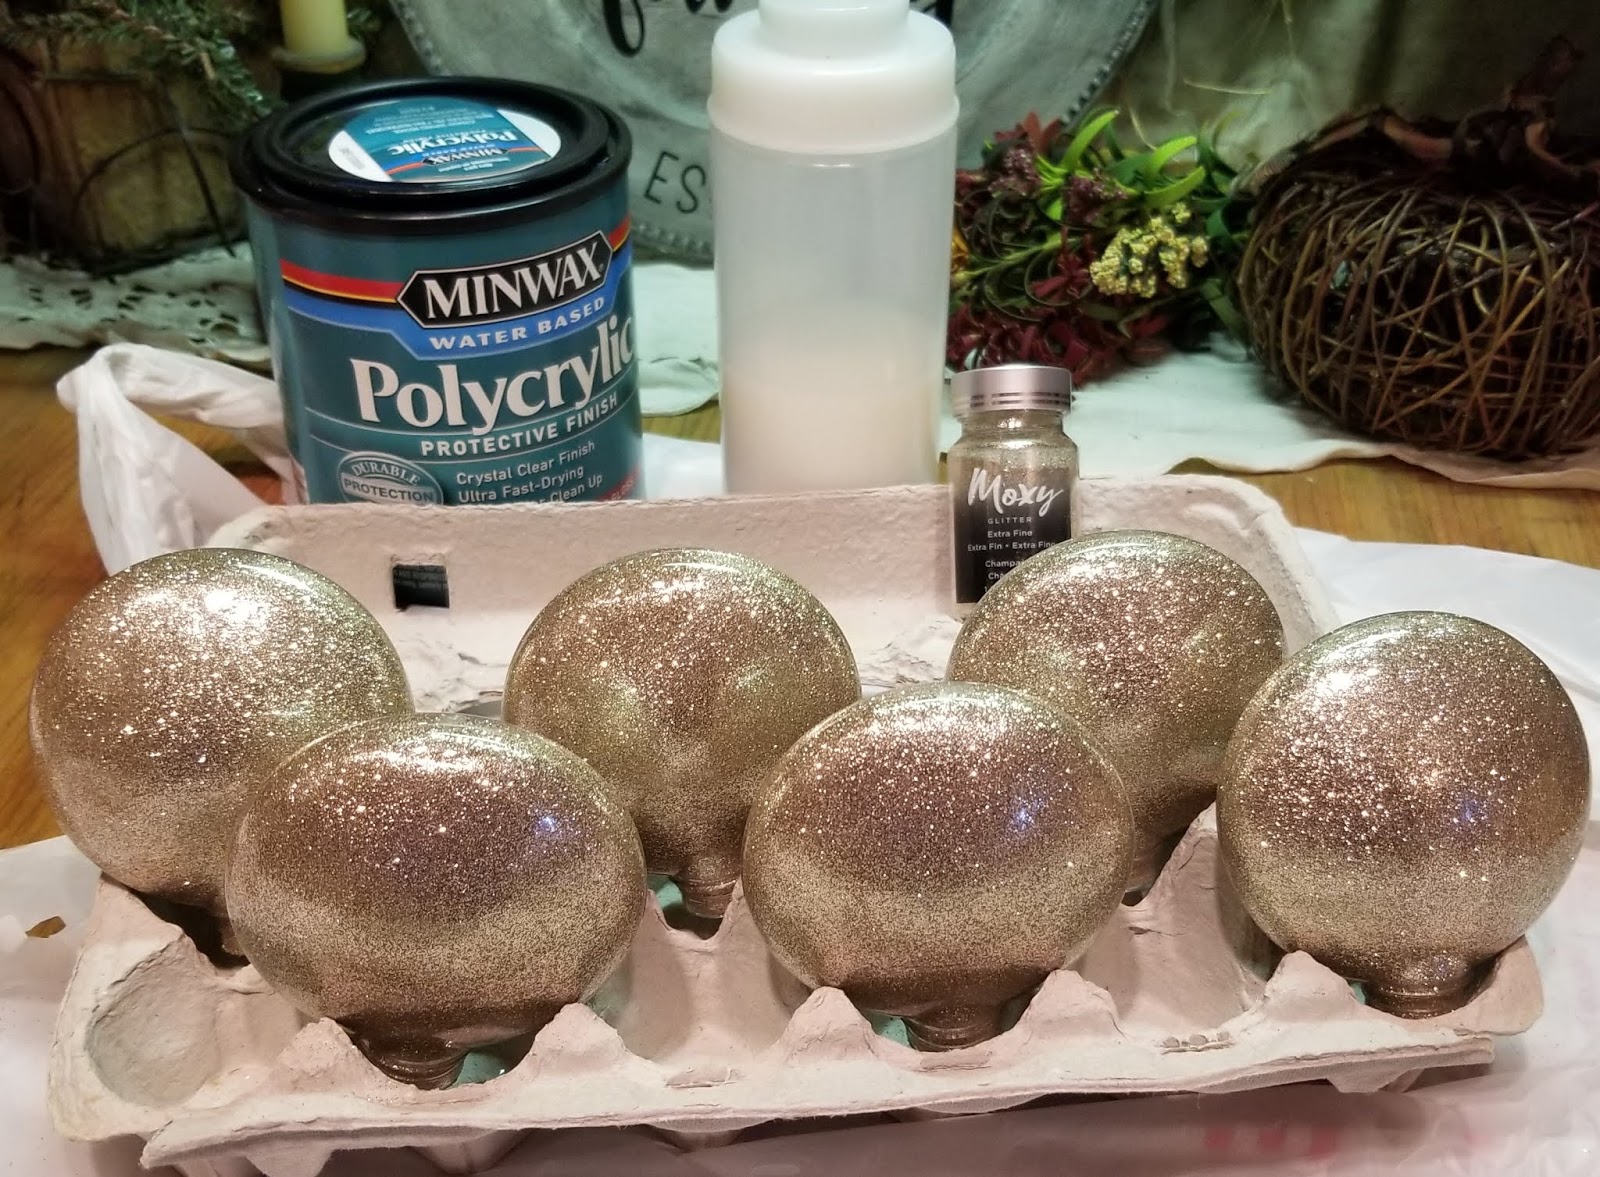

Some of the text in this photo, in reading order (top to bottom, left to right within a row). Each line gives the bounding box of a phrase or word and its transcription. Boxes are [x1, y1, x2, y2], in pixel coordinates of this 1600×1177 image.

[388, 129, 519, 155] Polycrylic
[433, 146, 503, 165] MINWAX
[423, 241, 601, 319] MINWAX
[429, 297, 605, 350] WATER BASED
[350, 314, 633, 436] Polycrylic
[421, 391, 618, 457] PROTECTIVE FINISH
[351, 461, 421, 486] DURABLE
[456, 440, 595, 487] Crystal Clear Finish
[344, 478, 434, 502] PROTECTION
[458, 465, 584, 504] Ultra Fast-Drying
[550, 474, 603, 503] Clean Up
[967, 467, 1064, 517] Moxy
[987, 517, 1032, 525] GLITTER
[987, 529, 1033, 538] Extra Fine
[967, 543, 987, 552] Extra
[988, 542, 1003, 550] Fin
[1012, 541, 1036, 550] Extra
